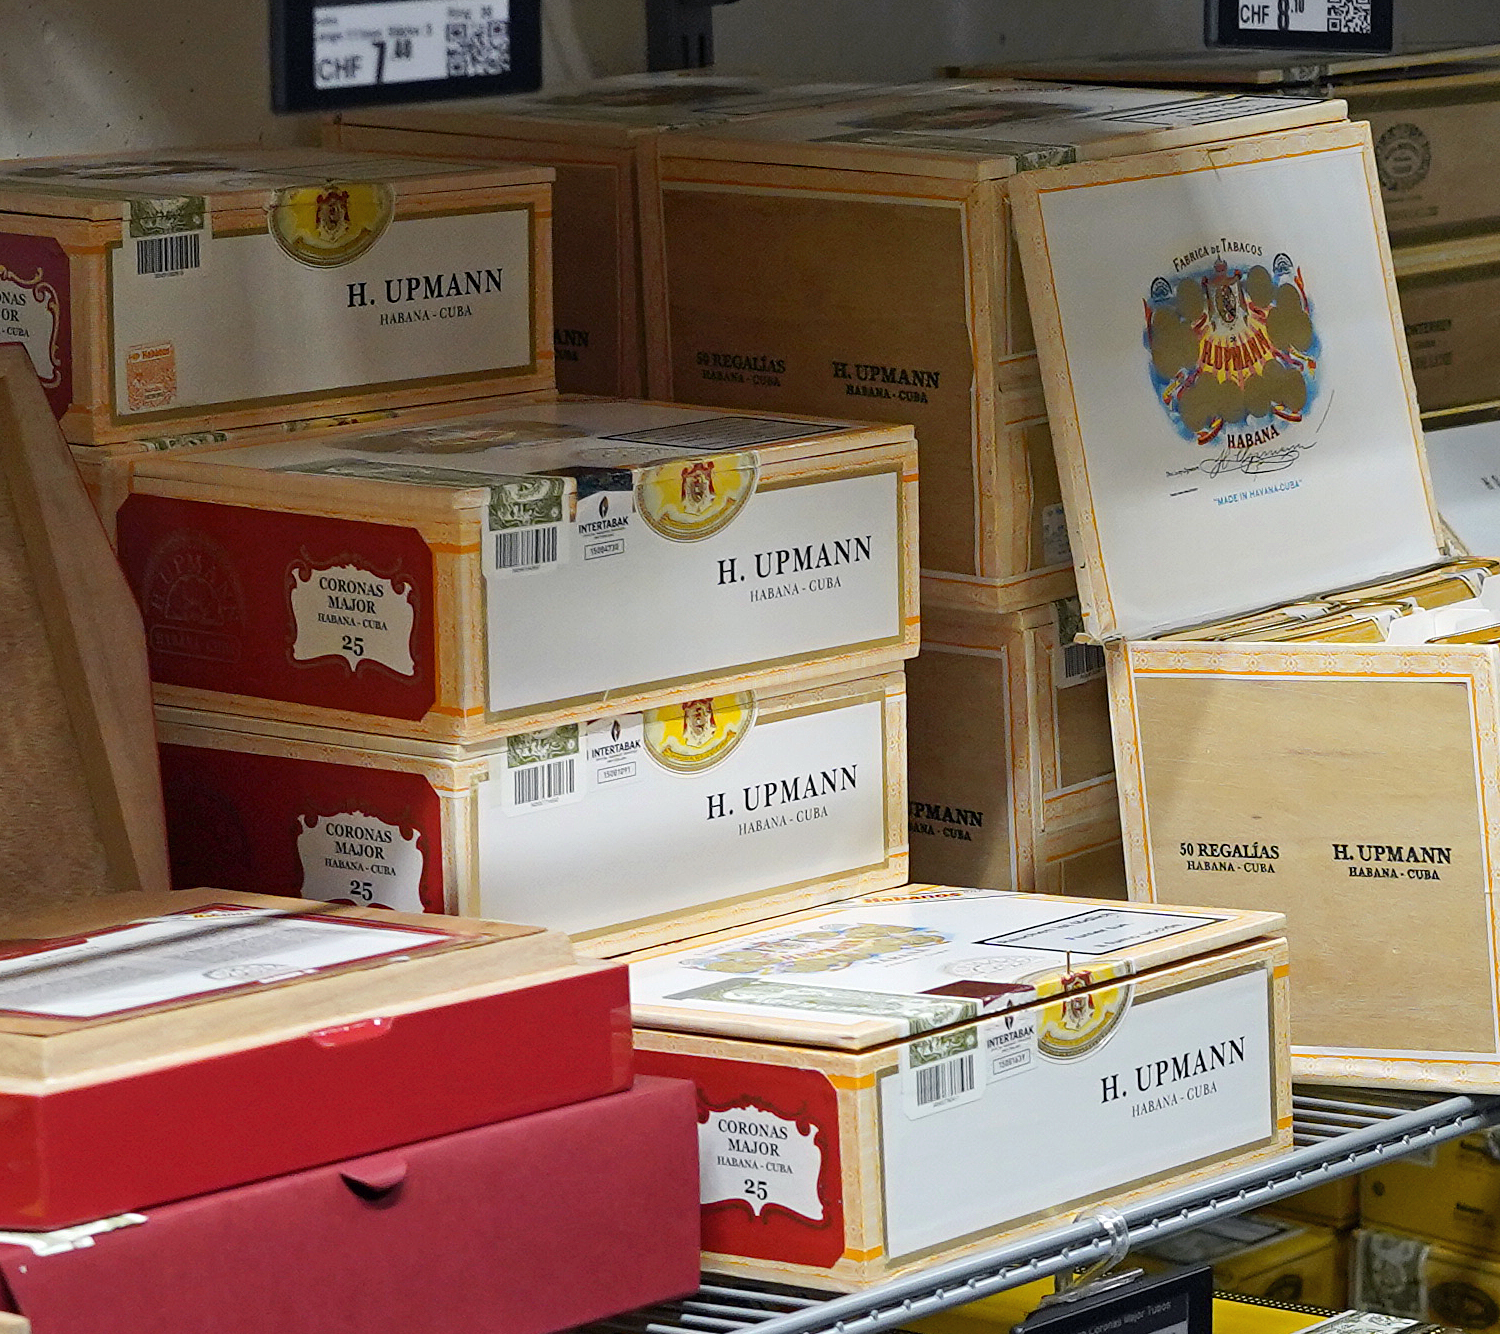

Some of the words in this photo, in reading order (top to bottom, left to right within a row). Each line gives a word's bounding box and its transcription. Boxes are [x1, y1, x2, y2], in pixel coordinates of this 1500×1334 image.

[1240, 5, 1269, 24] CHF
[347, 281, 377, 309] H.
[383, 268, 504, 304] UPMANN
[379, 309, 429, 327] HABANA
[438, 305, 473, 321] CUBA
[714, 351, 786, 375] REGALÍAS
[832, 361, 851, 381] H.
[854, 363, 941, 390] UPMANN
[1227, 425, 1280, 450] HABANA
[578, 515, 630, 537] INTERTABAK
[717, 558, 745, 586] H.
[753, 535, 873, 581] UPMANN
[319, 575, 385, 598] CORONAS
[750, 584, 801, 603] HABANA
[809, 576, 842, 593] CUBA
[327, 596, 377, 615] MAJOR
[341, 635, 365, 658] 25
[591, 739, 642, 761] INTERTABAK
[706, 792, 735, 821] H.
[743, 764, 859, 813] UPMANN
[738, 816, 788, 836] HABANA
[797, 806, 830, 823] CUBA
[325, 822, 393, 844] CORONAS
[334, 842, 385, 861] MAJOR
[1179, 840, 1195, 858] 50
[1198, 840, 1280, 862] REGALÍAS
[1333, 843, 1354, 864] H.
[1358, 844, 1452, 865] UPMANN
[1186, 858, 1233, 873] HABANA
[1243, 861, 1276, 875] CUBA
[1348, 865, 1394, 879] HABANA
[1409, 866, 1441, 882] CUBA
[349, 880, 373, 902] 25
[986, 1023, 1036, 1048] INTERTABAK
[1100, 1073, 1128, 1105] H.
[1136, 1036, 1247, 1093] UPMANN
[1131, 1097, 1174, 1119] HABANA
[1183, 1081, 1219, 1102] CUBA
[717, 1119, 789, 1141] CORONAS
[727, 1138, 781, 1159] MAJOR
[744, 1178, 769, 1201] 25
